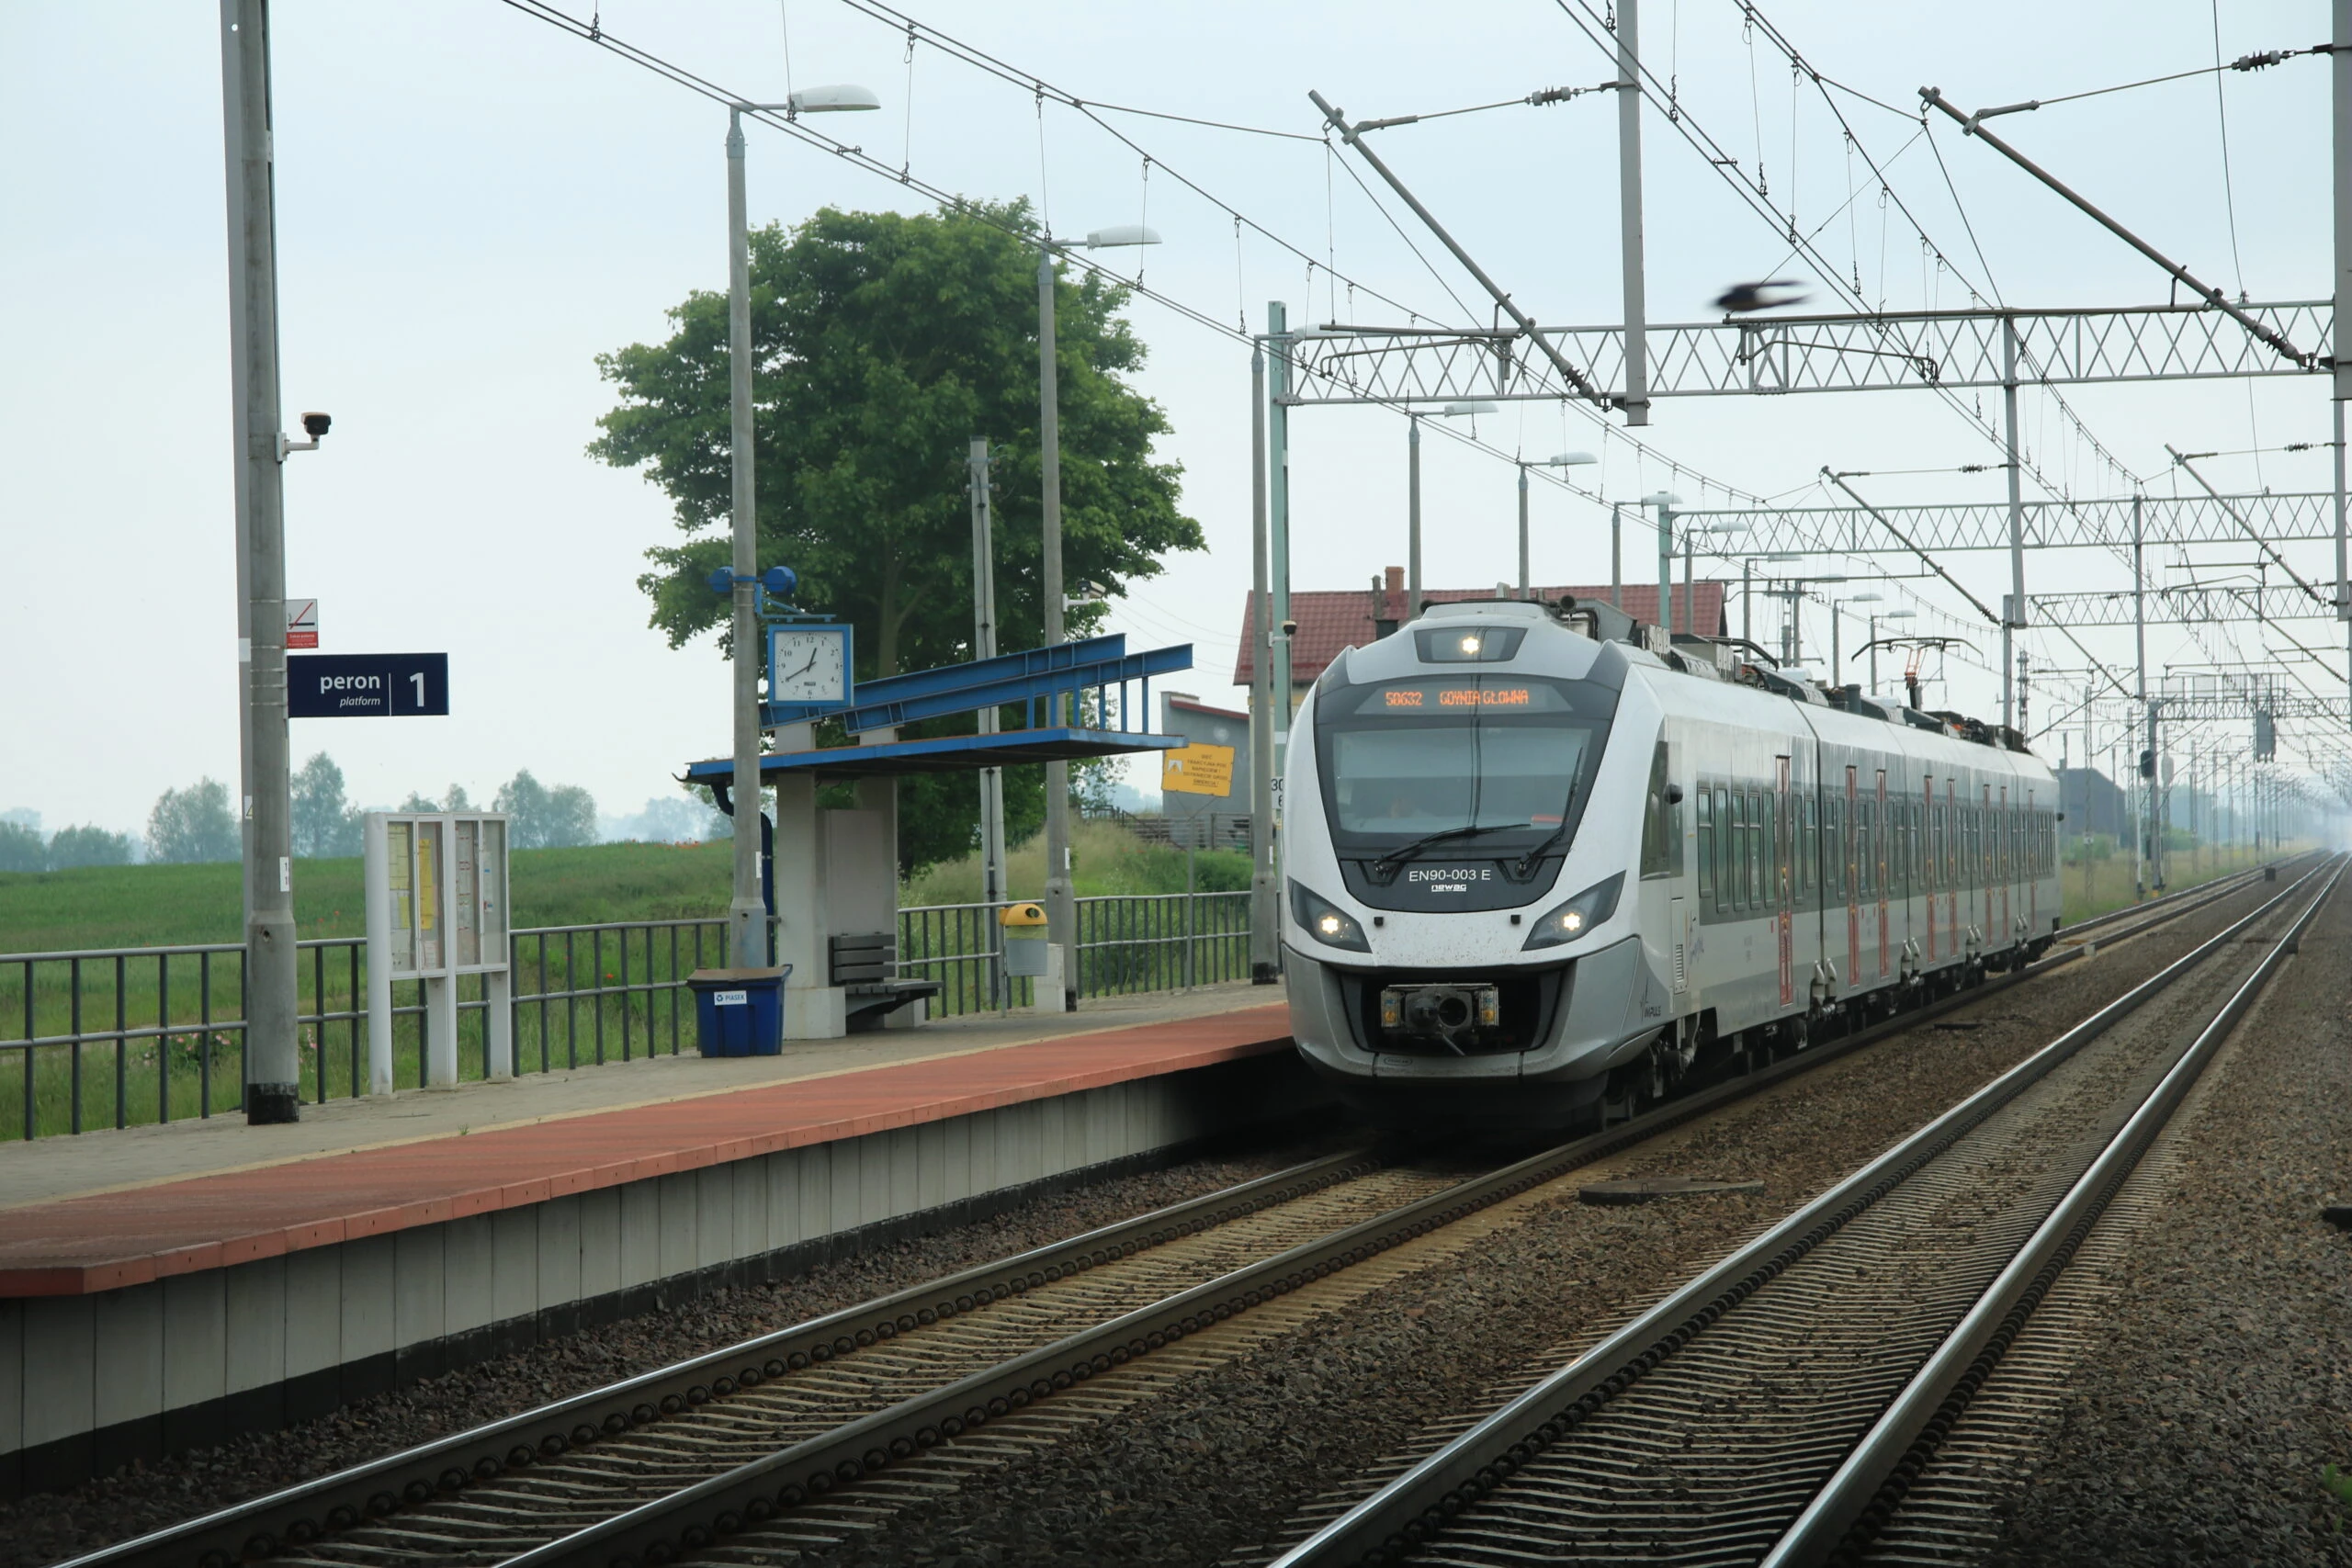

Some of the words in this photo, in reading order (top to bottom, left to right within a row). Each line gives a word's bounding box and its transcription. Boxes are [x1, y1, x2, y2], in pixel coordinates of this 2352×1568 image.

[320, 675, 380, 694] peron
[410, 671, 424, 707] 1
[339, 695, 380, 707] platform
[1385, 691, 1423, 706] 50632
[1440, 690, 1481, 706] GDYNIA
[1408, 869, 1476, 882] EN90-003
[1481, 869, 1491, 881] E
